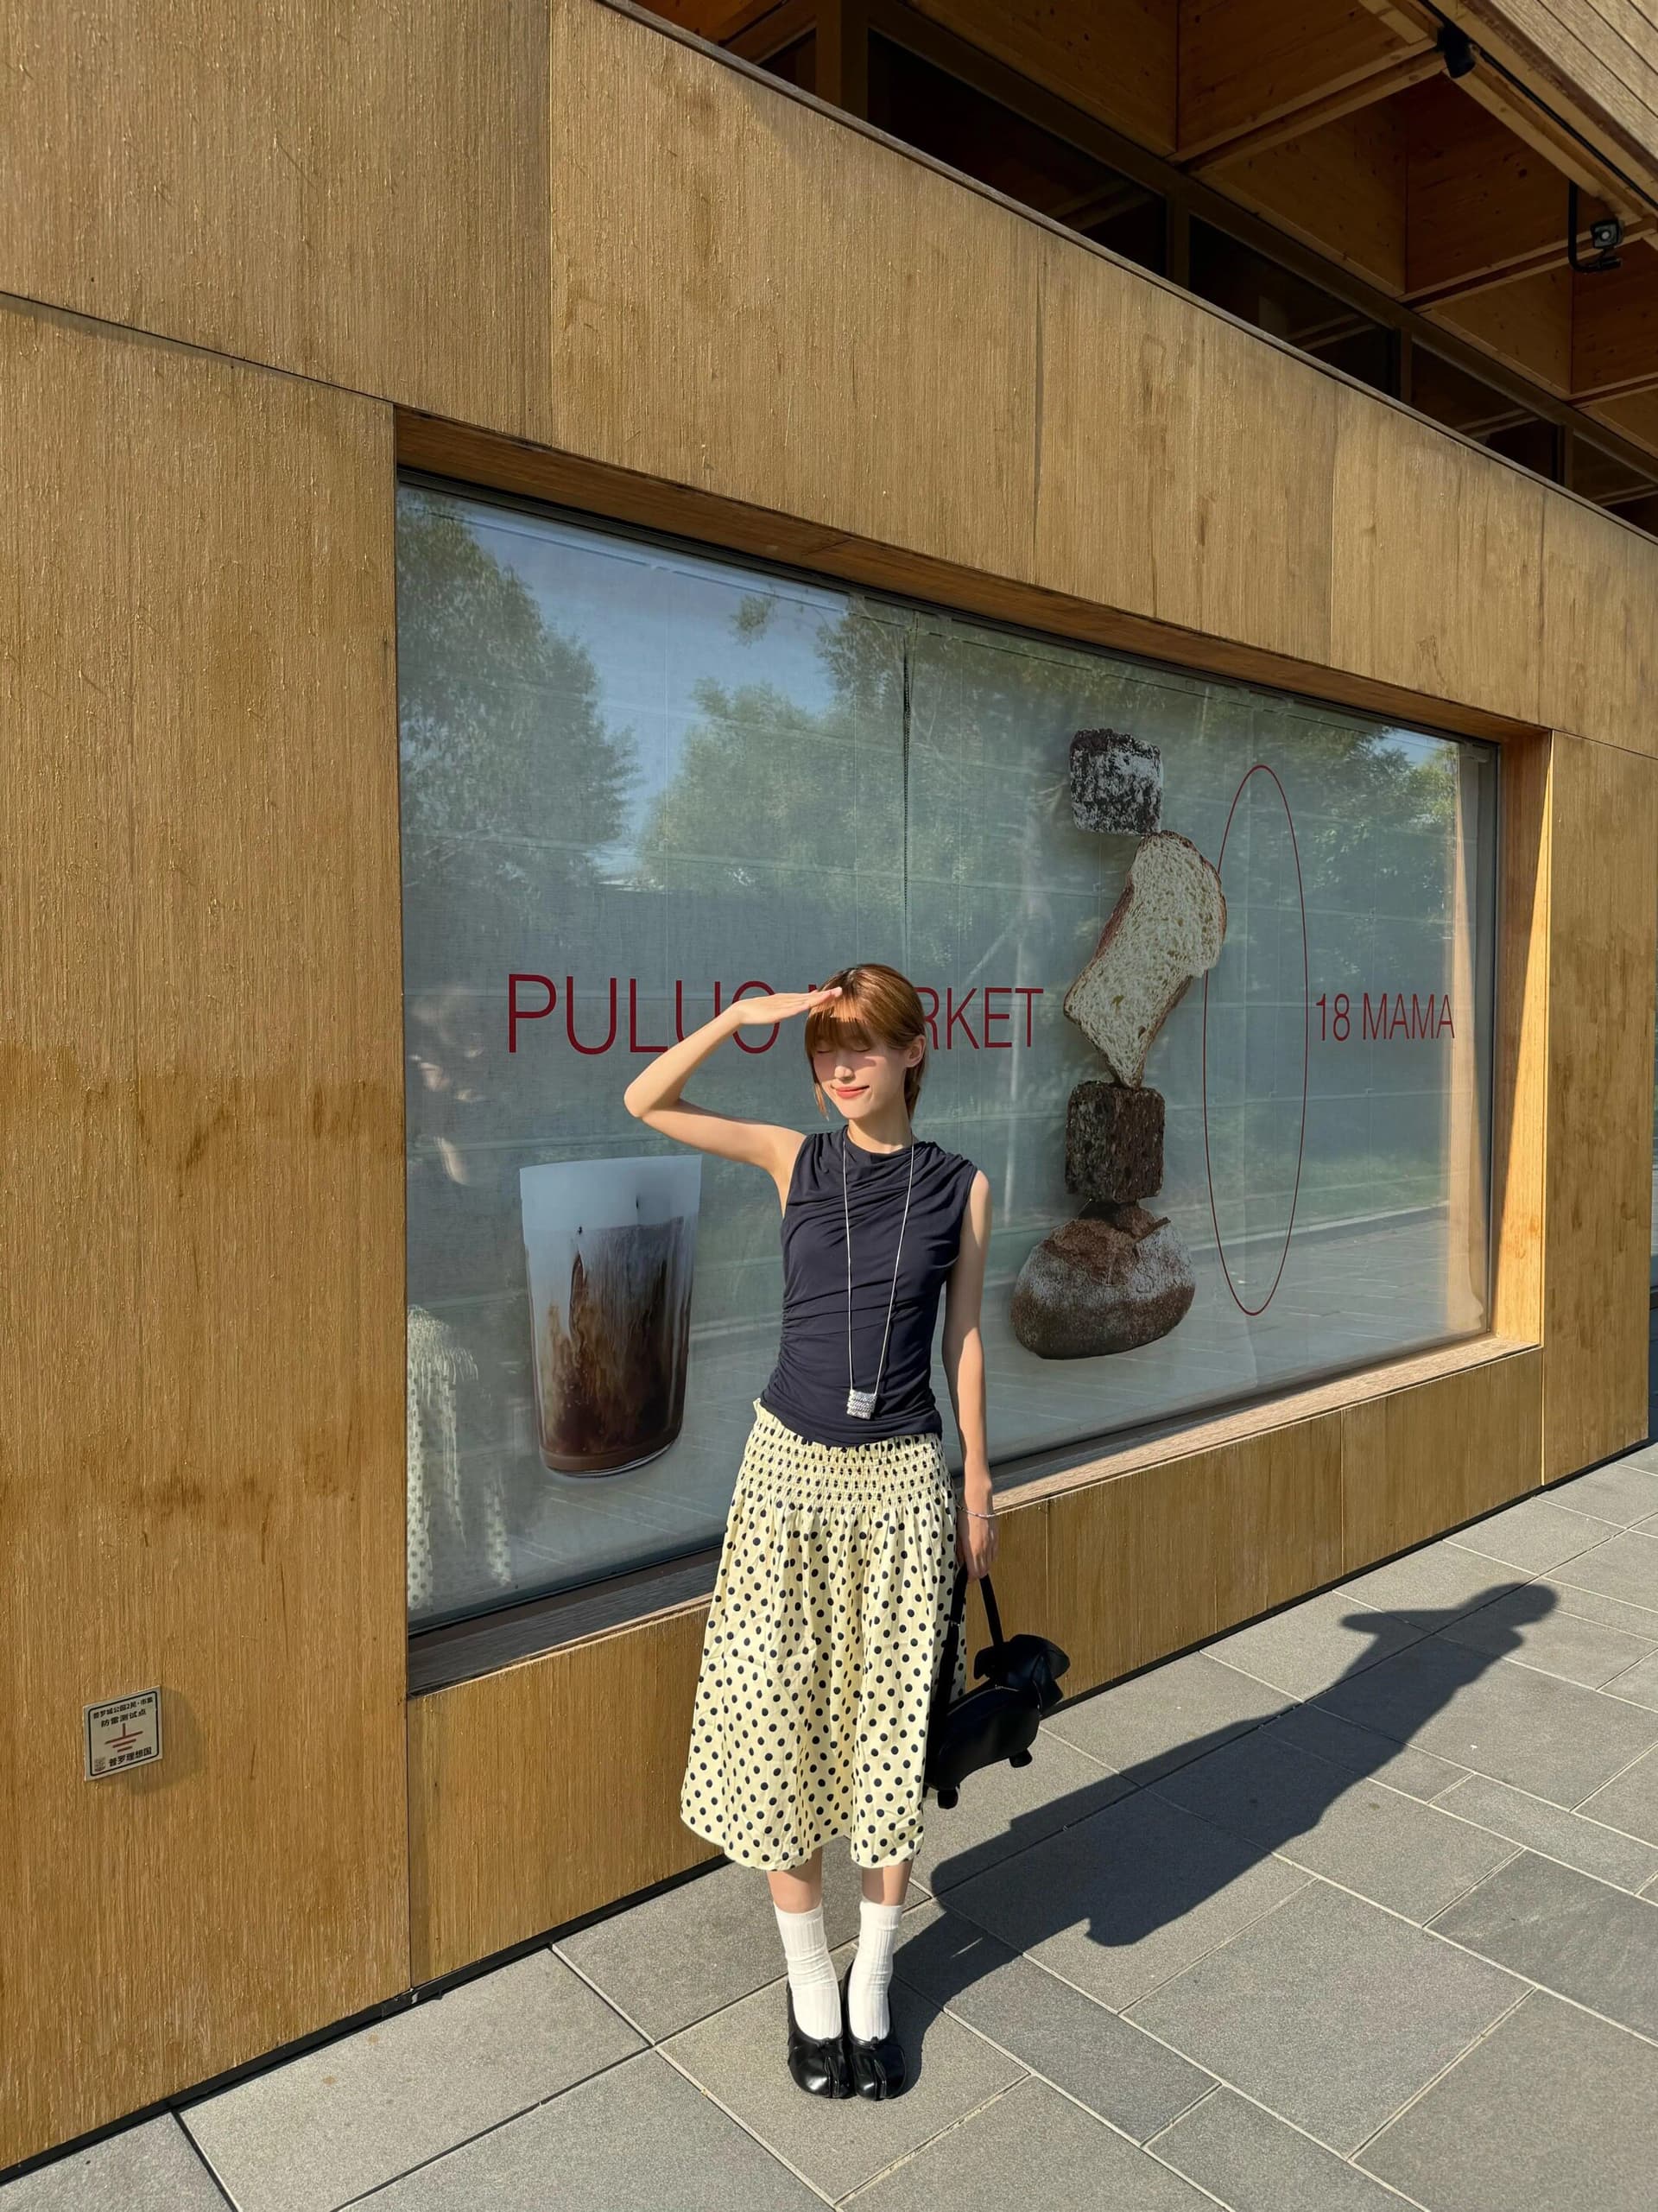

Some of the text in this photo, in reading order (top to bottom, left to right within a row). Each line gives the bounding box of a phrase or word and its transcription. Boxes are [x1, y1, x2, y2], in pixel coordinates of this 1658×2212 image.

[808, 983, 1045, 1050] RKET
[1315, 992, 1455, 1042] 18 MAMA
